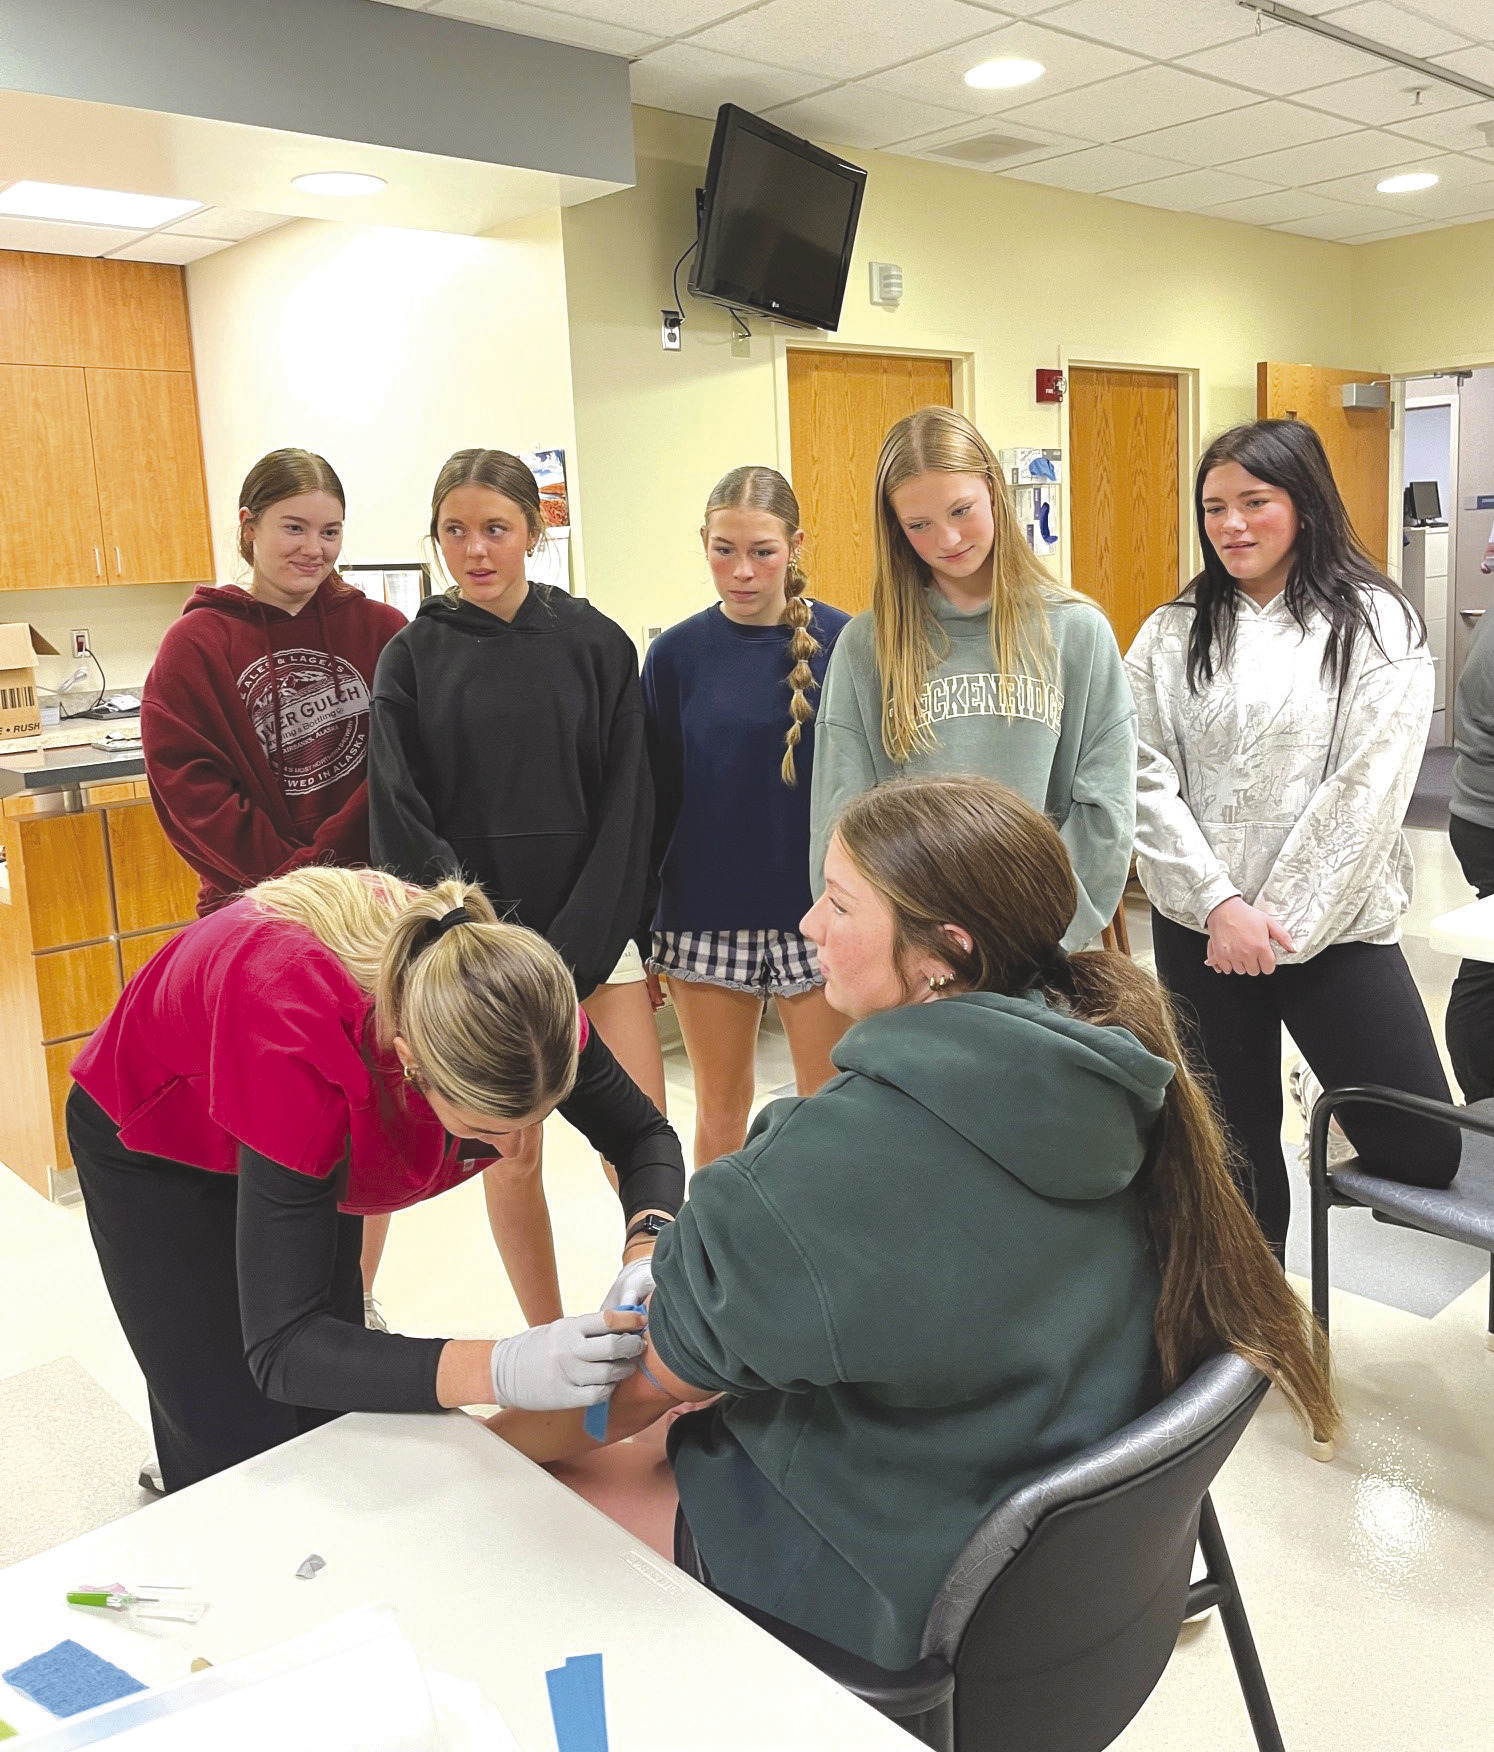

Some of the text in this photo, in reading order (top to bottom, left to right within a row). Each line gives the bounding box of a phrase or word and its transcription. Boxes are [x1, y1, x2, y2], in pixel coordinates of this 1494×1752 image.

[13, 722, 41, 734] RUSH
[303, 708, 337, 731] Bottling
[317, 769, 331, 780] IN
[332, 733, 366, 773] ALASKA
